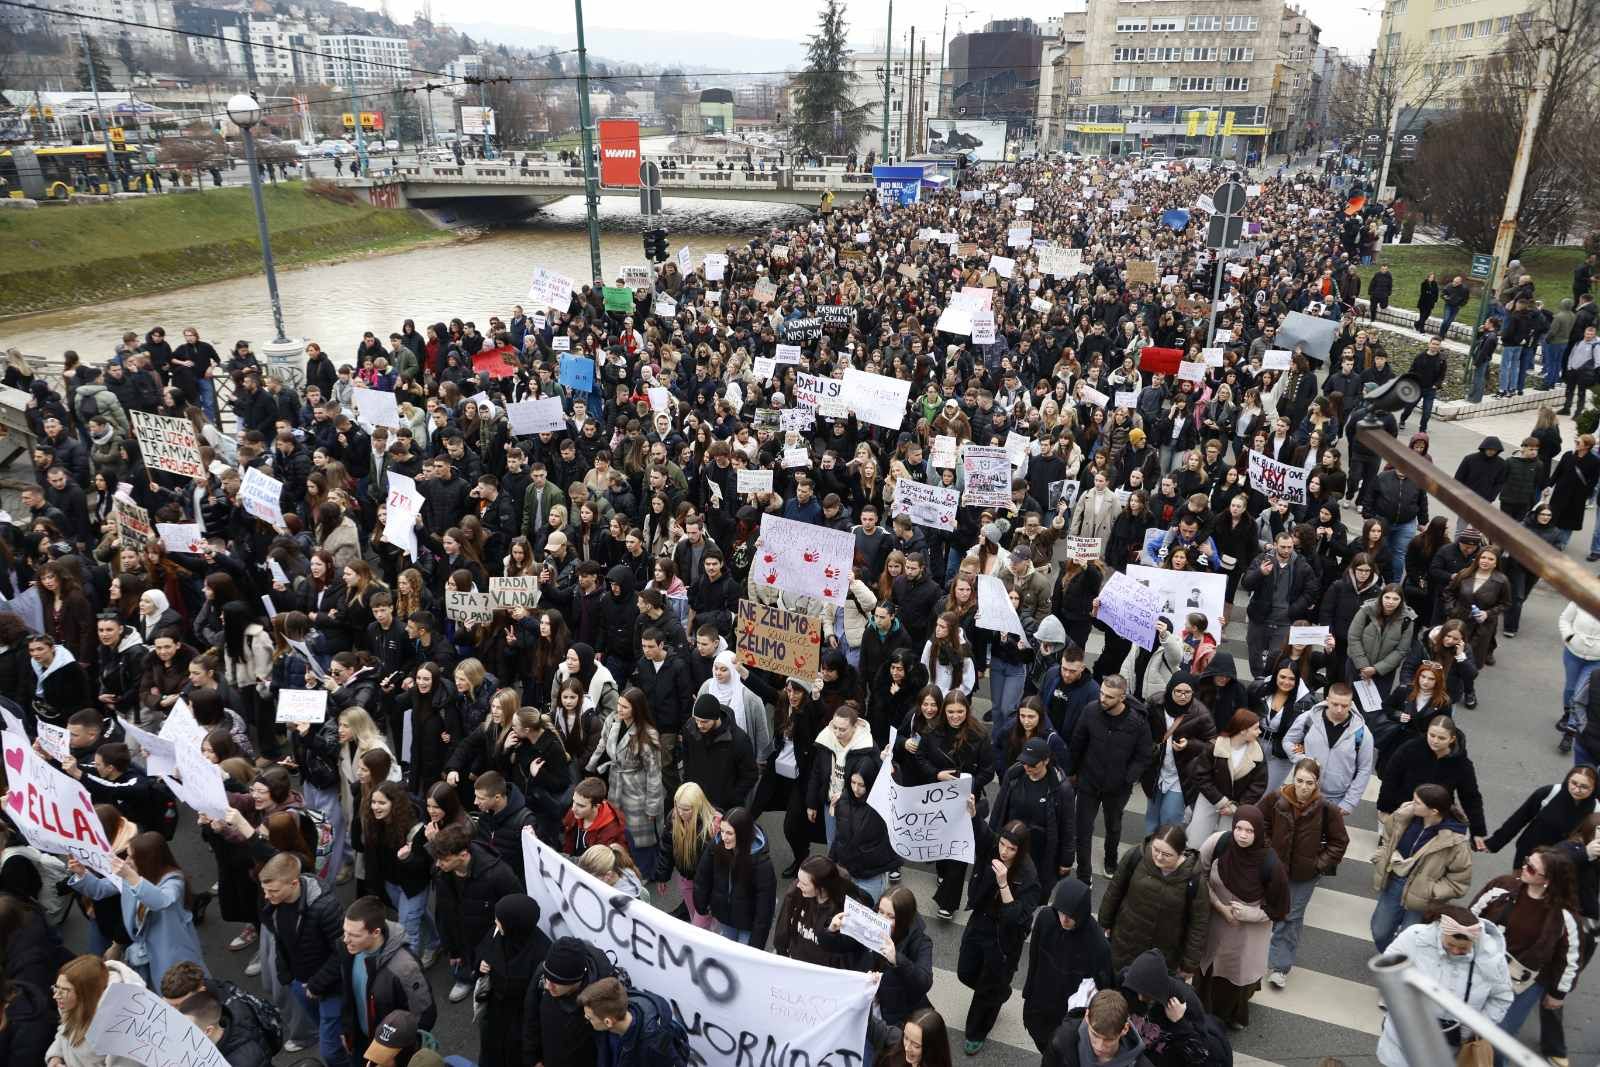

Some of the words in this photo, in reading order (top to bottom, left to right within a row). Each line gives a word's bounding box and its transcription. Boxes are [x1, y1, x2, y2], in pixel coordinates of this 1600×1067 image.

[1289, 470, 1304, 480] OVE
[500, 578, 528, 588] PADA
[451, 593, 477, 606] STA
[492, 590, 535, 607] VLADA
[740, 601, 756, 621] NE
[922, 783, 960, 804] JOŠ
[28, 782, 98, 846] ELLA
